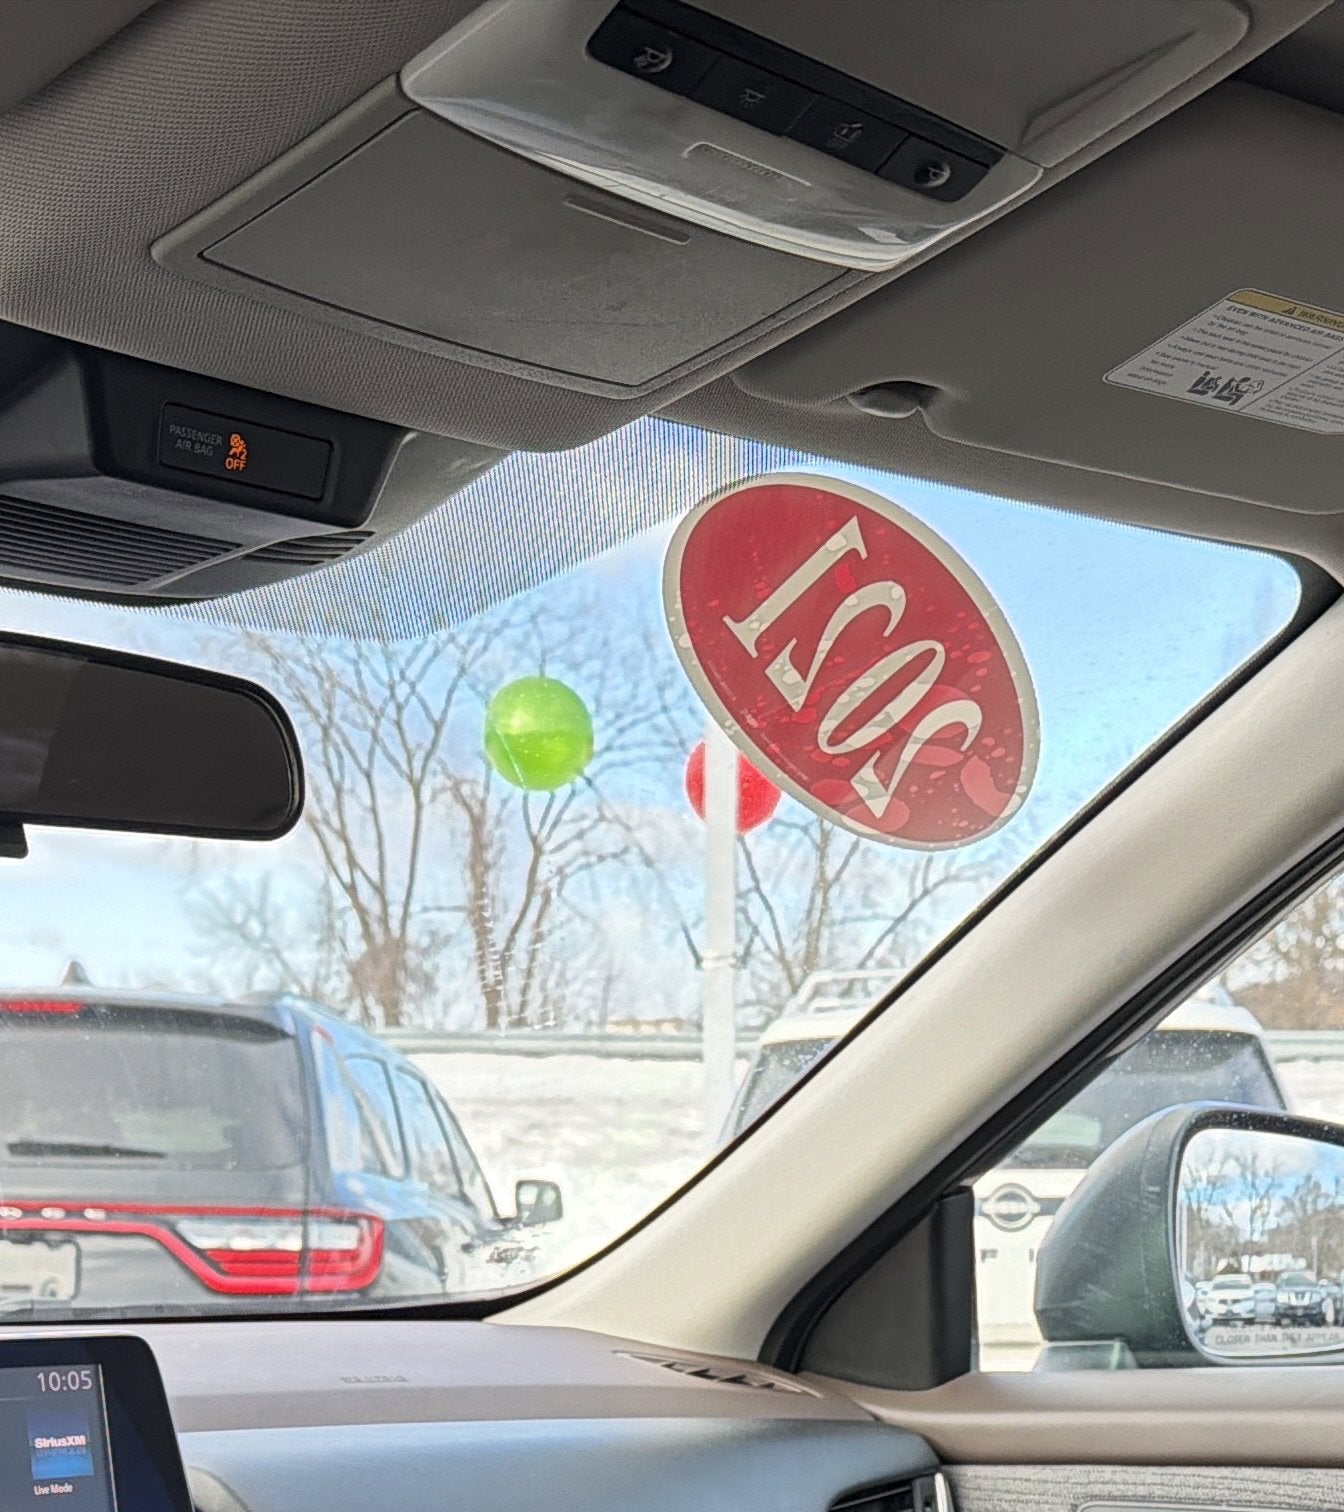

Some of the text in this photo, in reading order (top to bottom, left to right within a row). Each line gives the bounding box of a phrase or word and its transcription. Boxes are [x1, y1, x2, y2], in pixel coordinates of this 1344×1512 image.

[169, 424, 223, 445] PASSENGER
[175, 438, 214, 456] AIR BAG
[225, 457, 247, 471] OFF
[37, 1370, 93, 1393] 10:05
[34, 1483, 73, 1496] Live Mode
